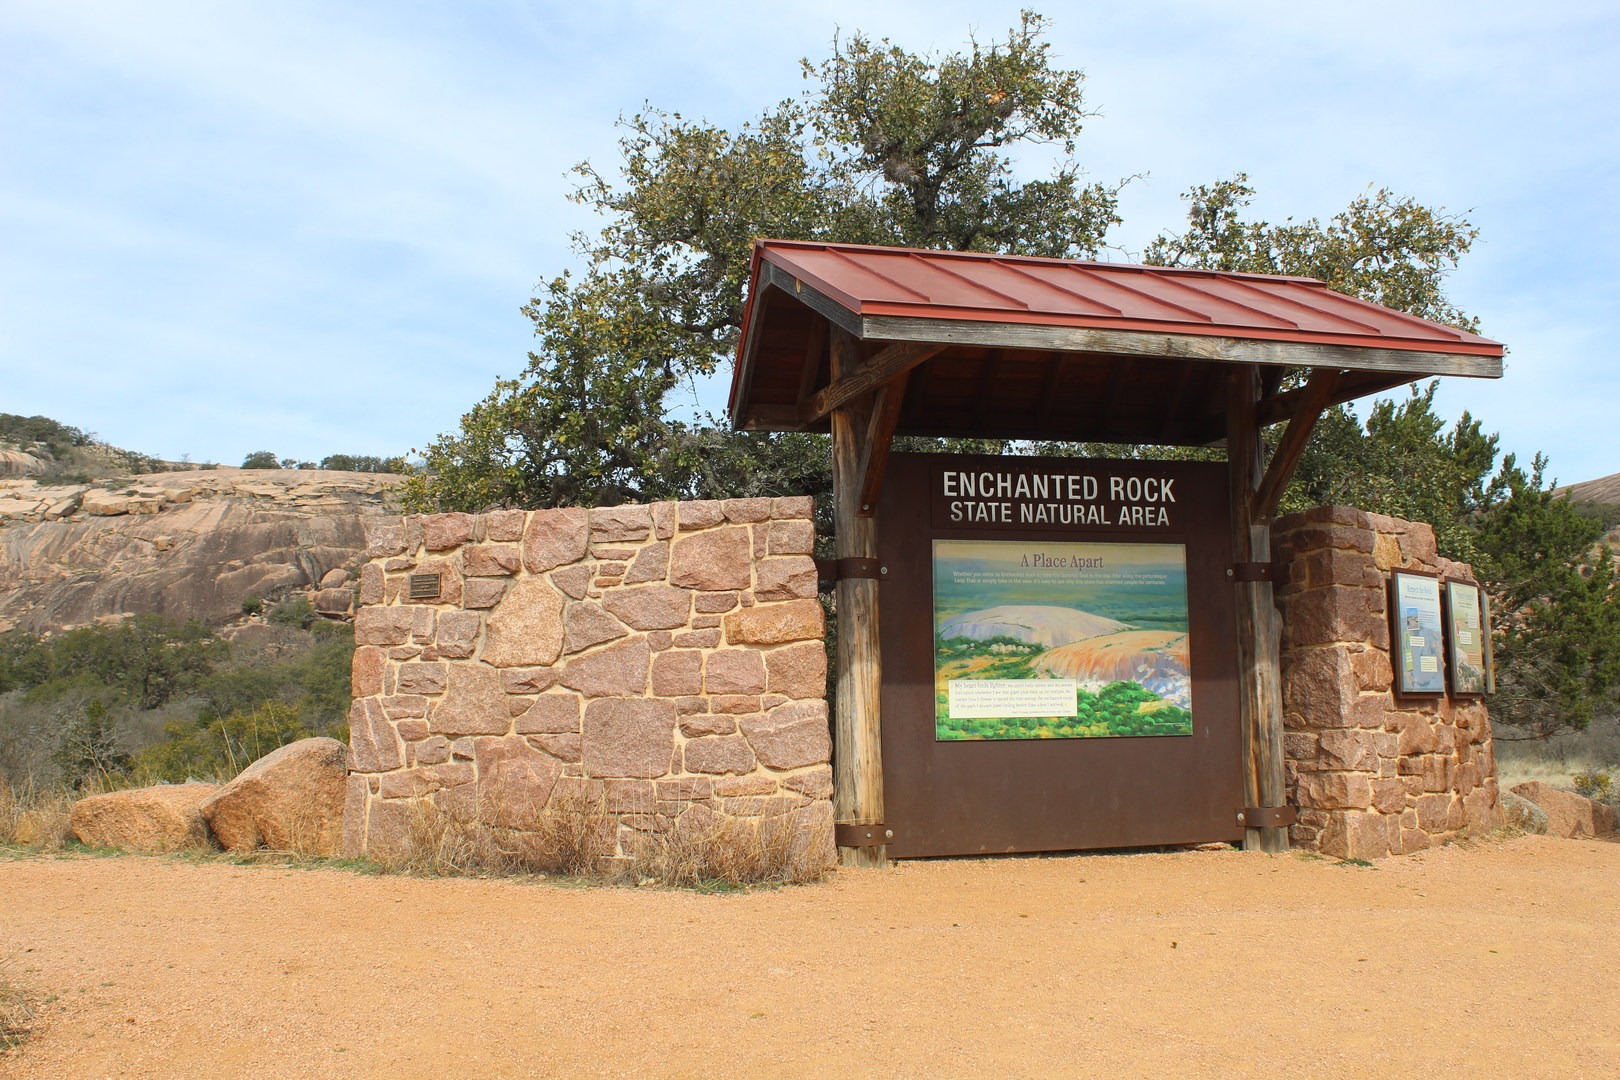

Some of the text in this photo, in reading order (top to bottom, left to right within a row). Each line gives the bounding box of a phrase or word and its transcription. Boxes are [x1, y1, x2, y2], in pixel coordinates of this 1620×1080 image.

[943, 472, 1176, 502] ENCHANTED ROCK
[950, 501, 1170, 526] STATE NATURAL AREA
[1021, 552, 1104, 571] A Place Apart
